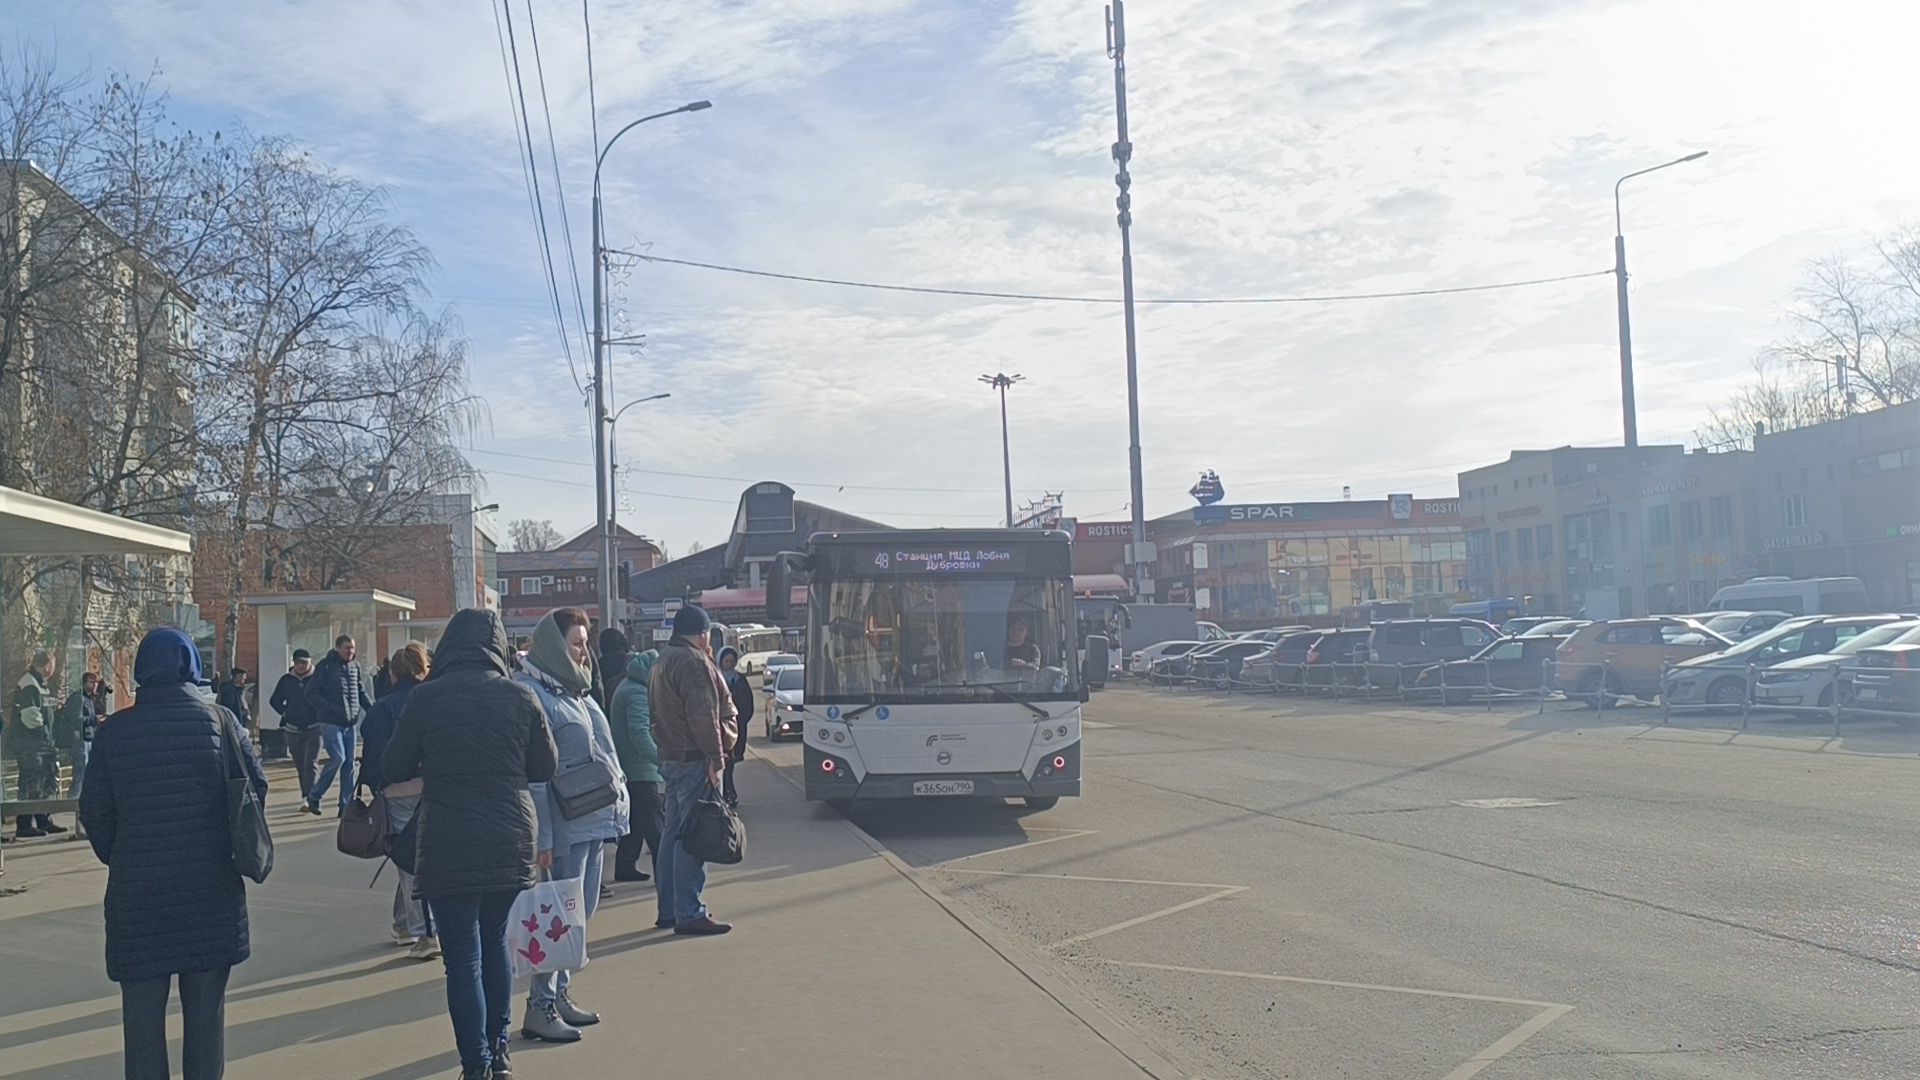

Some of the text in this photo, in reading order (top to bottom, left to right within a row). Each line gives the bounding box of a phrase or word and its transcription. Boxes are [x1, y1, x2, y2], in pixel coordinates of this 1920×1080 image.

[1230, 506, 1294, 520] SPAR
[875, 550, 1010, 569] 48 Станция МЦД Лобня
[926, 560, 980, 570] Дубровки
